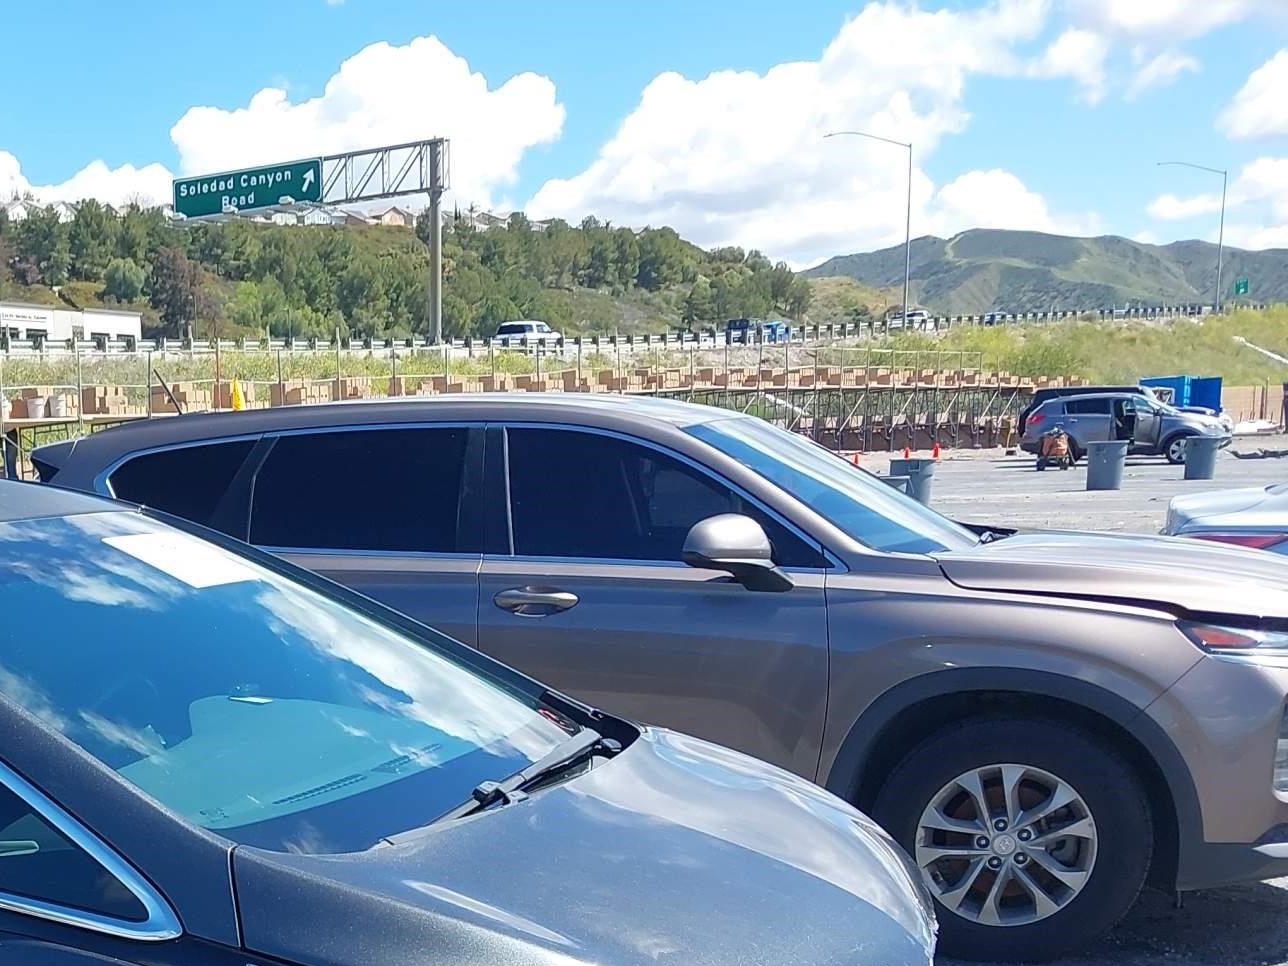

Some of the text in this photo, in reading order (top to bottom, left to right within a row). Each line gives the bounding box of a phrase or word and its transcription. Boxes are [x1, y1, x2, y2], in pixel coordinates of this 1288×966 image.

[179, 170, 292, 197] Soledad Canyon
[221, 192, 255, 209] Road
